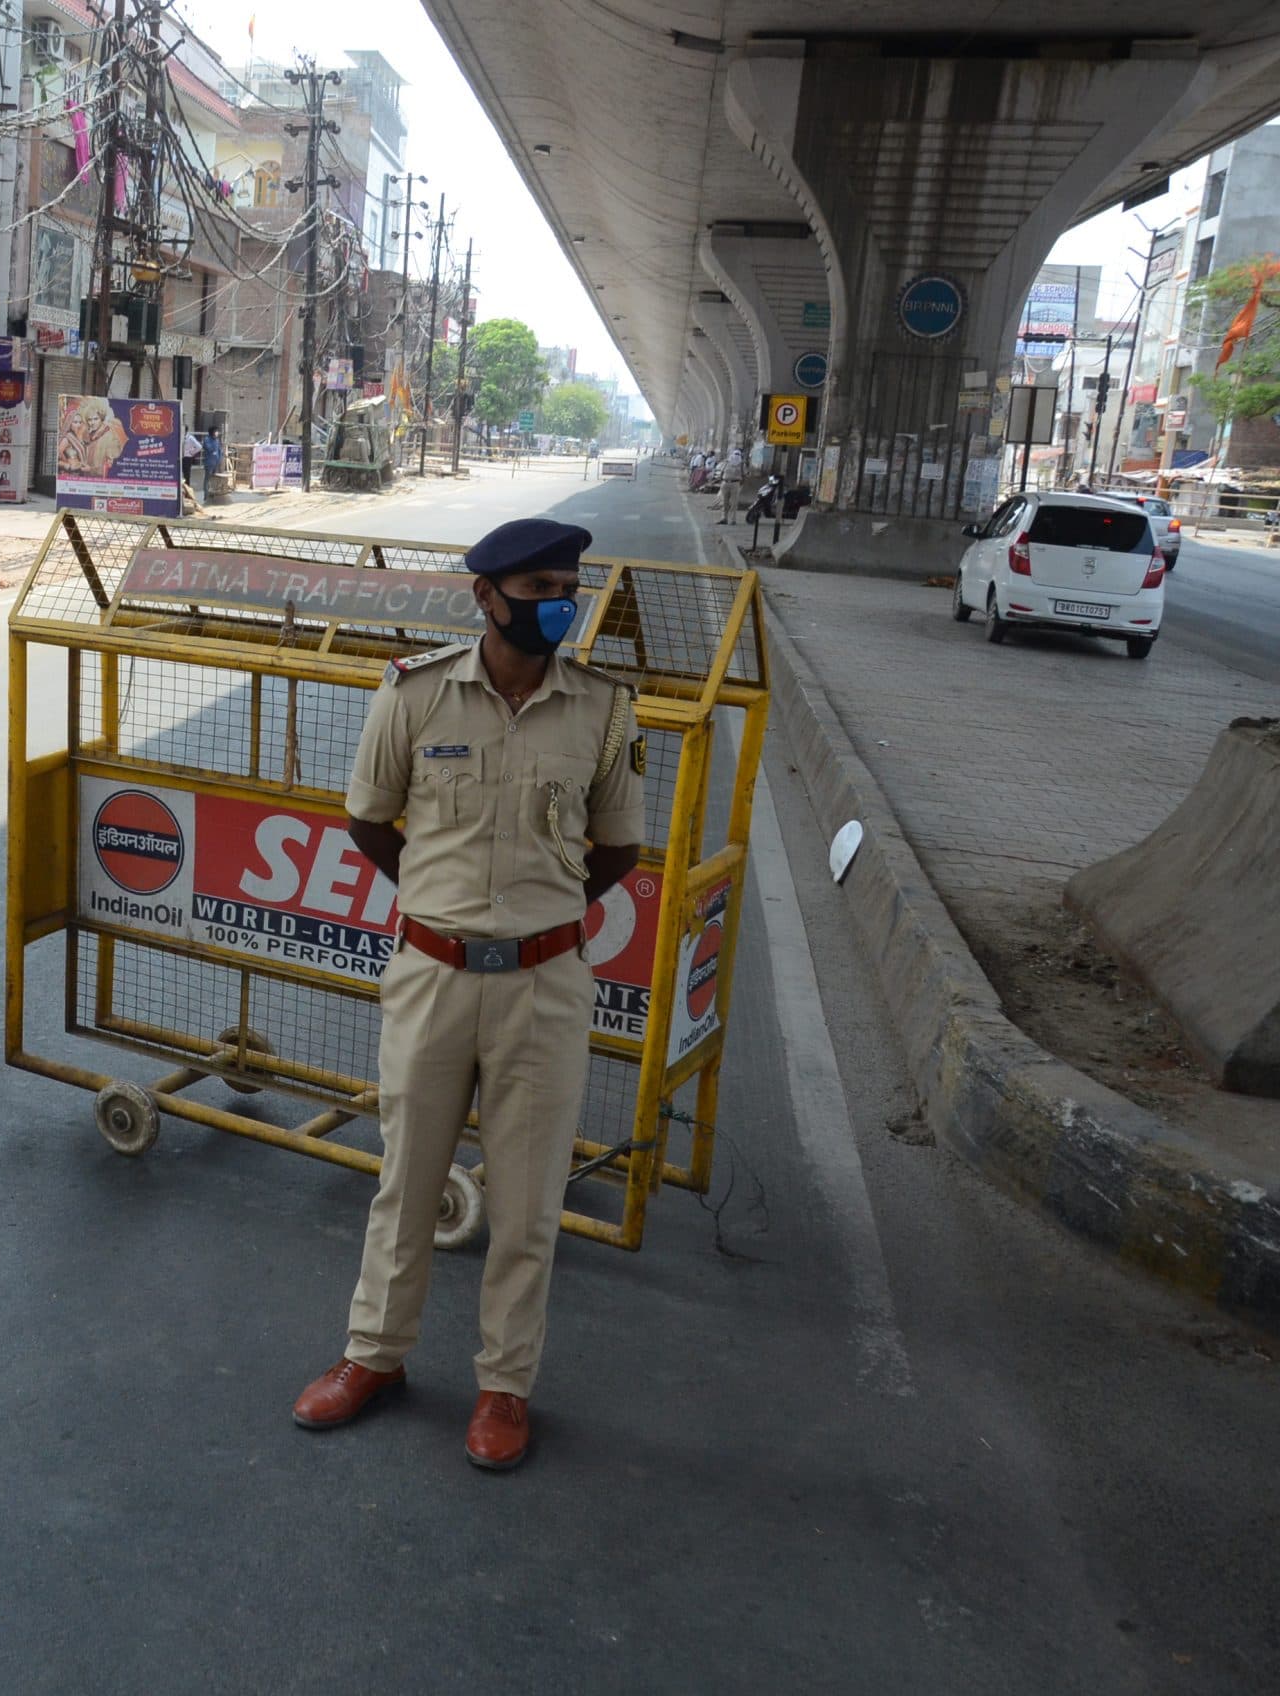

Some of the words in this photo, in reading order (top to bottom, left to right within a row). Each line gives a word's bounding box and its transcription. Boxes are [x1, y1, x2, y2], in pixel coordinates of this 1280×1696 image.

[771, 428, 801, 439] Parking
[782, 407, 794, 422] P
[144, 557, 251, 596] PATNA
[264, 567, 413, 612] TRAFFIC
[90, 890, 184, 928] IndianOil
[196, 896, 396, 961] WORLD-CLAS
[204, 924, 260, 950] 100%
[266, 938, 388, 979] PERFORM
